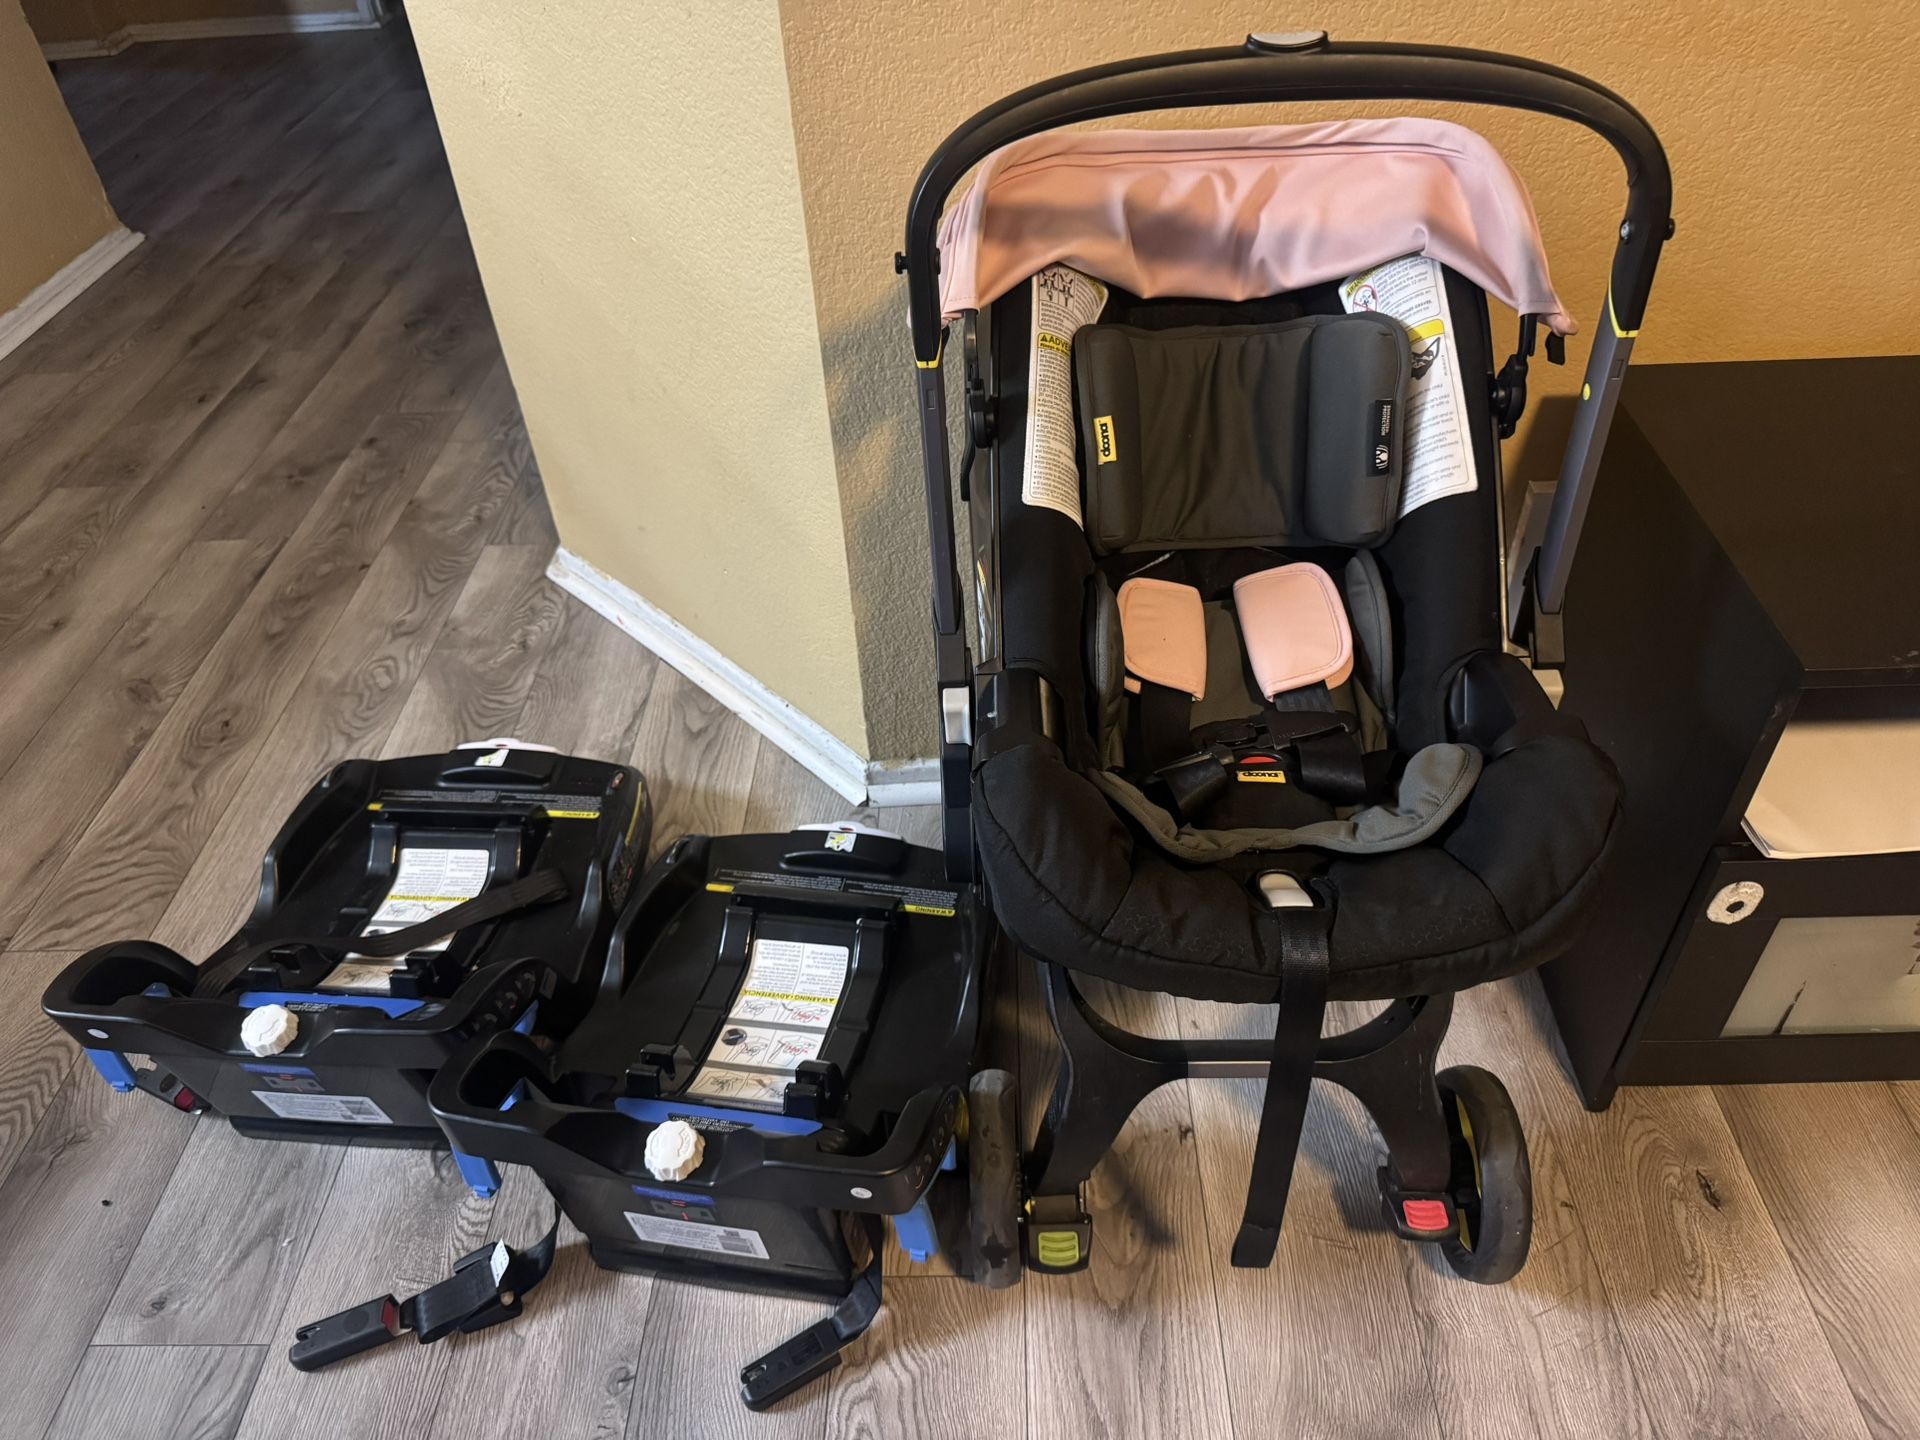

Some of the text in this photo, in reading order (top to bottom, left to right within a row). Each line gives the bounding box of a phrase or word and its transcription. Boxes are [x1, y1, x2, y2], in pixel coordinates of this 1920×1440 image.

[1099, 422, 1111, 458] doona
[1242, 770, 1279, 778] doona
[915, 906, 947, 914] WARNING
[744, 989, 791, 999] ADVERTENCIA
[794, 994, 828, 1003] WARNING
